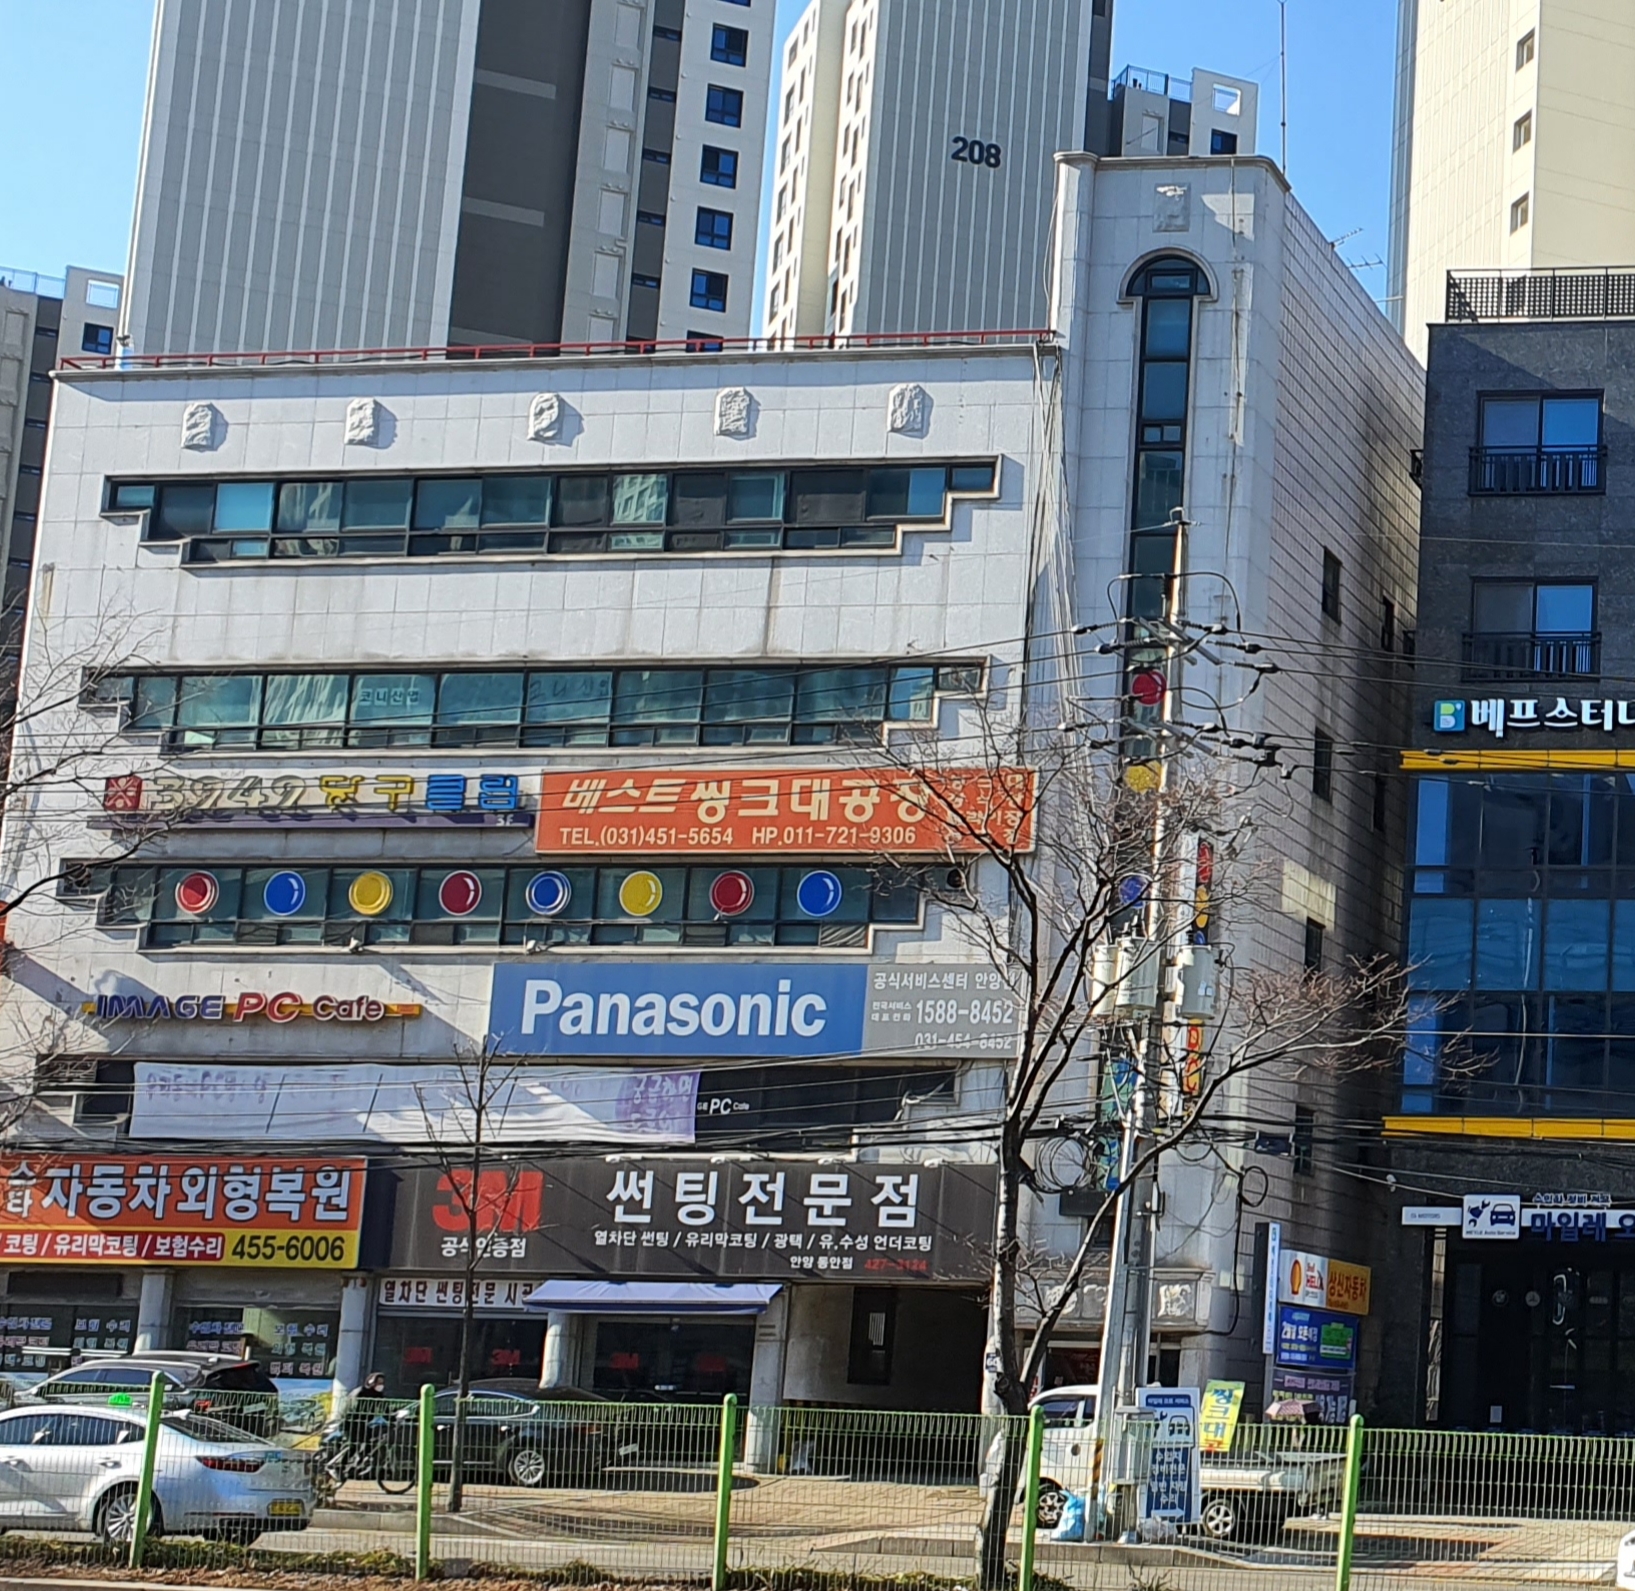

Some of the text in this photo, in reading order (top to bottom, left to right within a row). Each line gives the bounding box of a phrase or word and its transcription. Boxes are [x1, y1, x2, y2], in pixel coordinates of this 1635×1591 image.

[951, 136, 1002, 168] 208
[319, 774, 519, 812] 당구클럽
[560, 826, 916, 847] TEL.(031)451-5654 HP.011-721-9306
[873, 972, 968, 991] 공식서비스센터
[98, 992, 386, 1023] IMAGE PC Cafe
[520, 979, 827, 1036] Panasonic
[916, 999, 1014, 1025] 1588-8452
[708, 1098, 732, 1115] PC
[42, 1163, 351, 1222] 자동차외형복원
[432, 1169, 543, 1232] 3M
[605, 1168, 919, 1229] 썬팅전문점
[594, 1230, 933, 1252] 열차단 썬팅 유리막코팅 광택 언더코팅
[1531, 1212, 1607, 1243] 마일레
[3, 1232, 39, 1256] 코팅
[54, 1233, 138, 1259] 유리막코팅
[154, 1234, 222, 1259] 보험수리
[231, 1234, 346, 1263] 455-6006
[384, 1280, 428, 1304] 열차단
